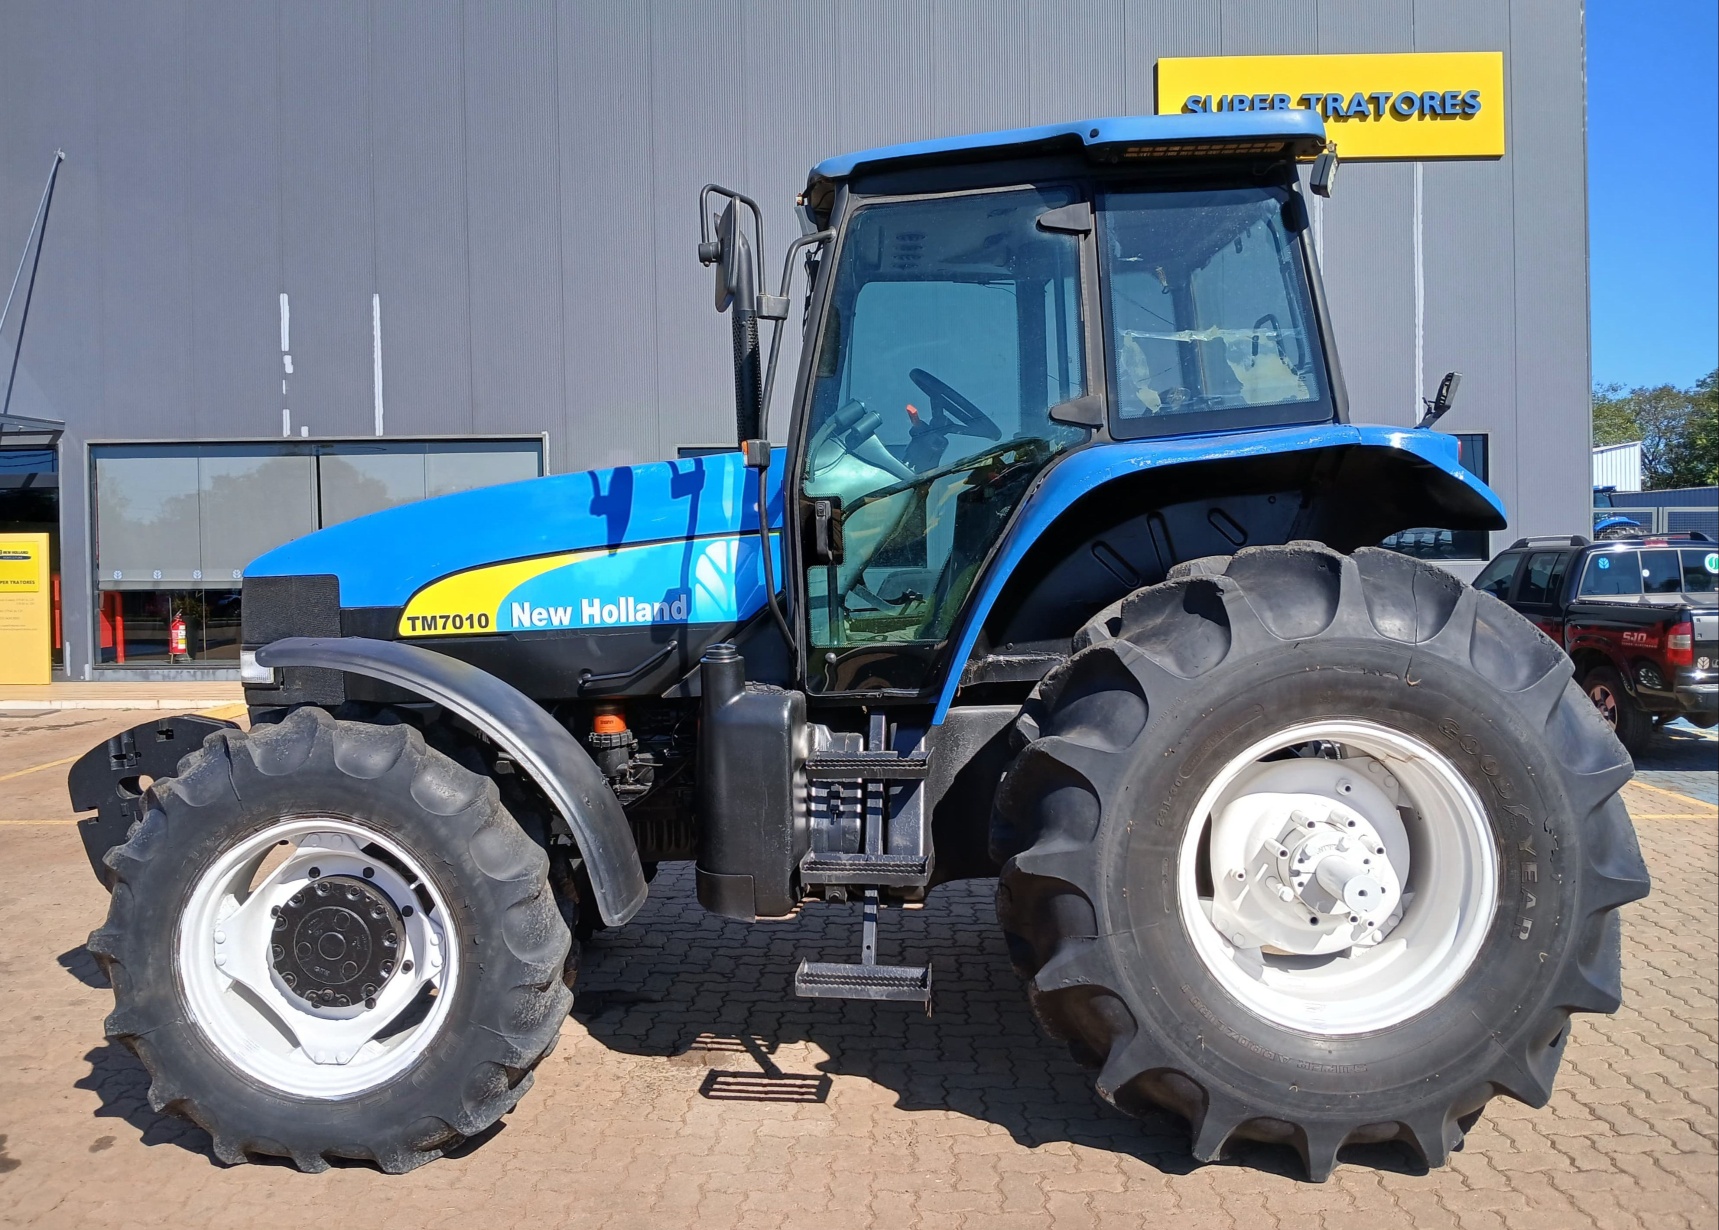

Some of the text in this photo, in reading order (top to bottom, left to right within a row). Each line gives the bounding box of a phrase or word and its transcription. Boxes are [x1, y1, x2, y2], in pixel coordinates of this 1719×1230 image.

[1183, 90, 1482, 117] SUPER TRATORES
[406, 613, 490, 633] TM7010
[509, 594, 688, 628] New Holland
